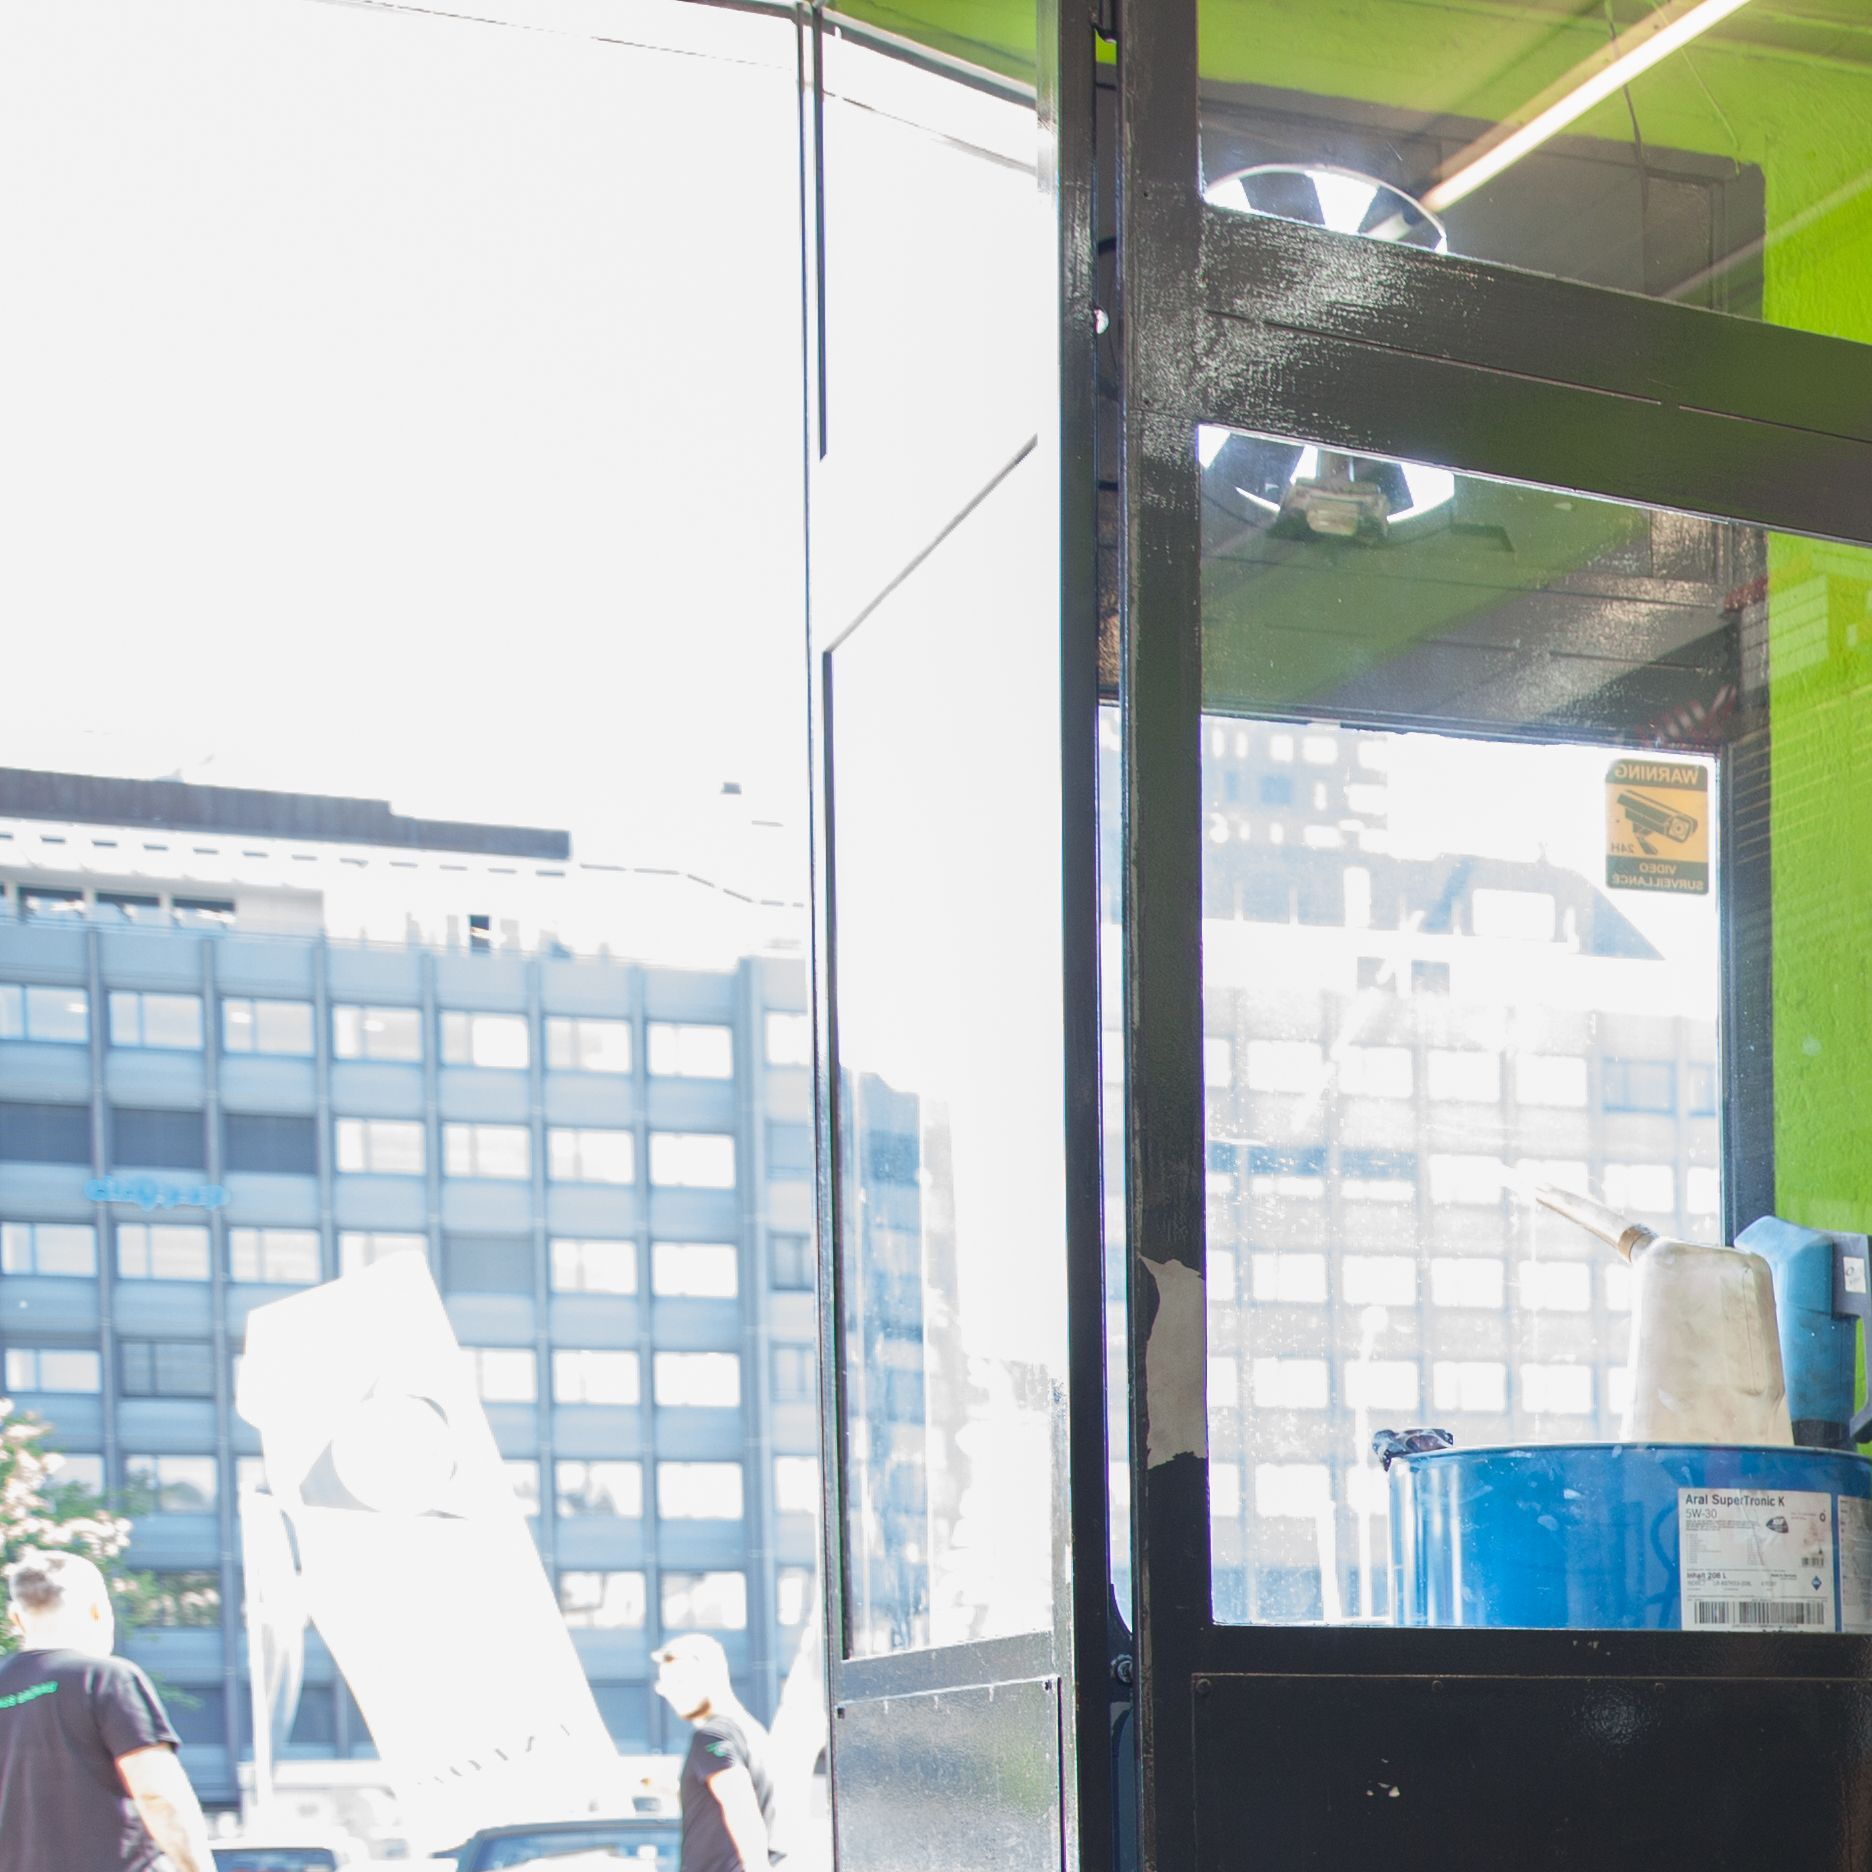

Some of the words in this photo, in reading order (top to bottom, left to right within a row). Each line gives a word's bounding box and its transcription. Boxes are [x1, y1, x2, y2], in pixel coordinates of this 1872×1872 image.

[1685, 1493, 1708, 1506] Aral
[1712, 1494, 1776, 1508] SuperTronic
[1778, 1495, 1785, 1507] K
[1685, 1508, 1718, 1519] 5W-30
